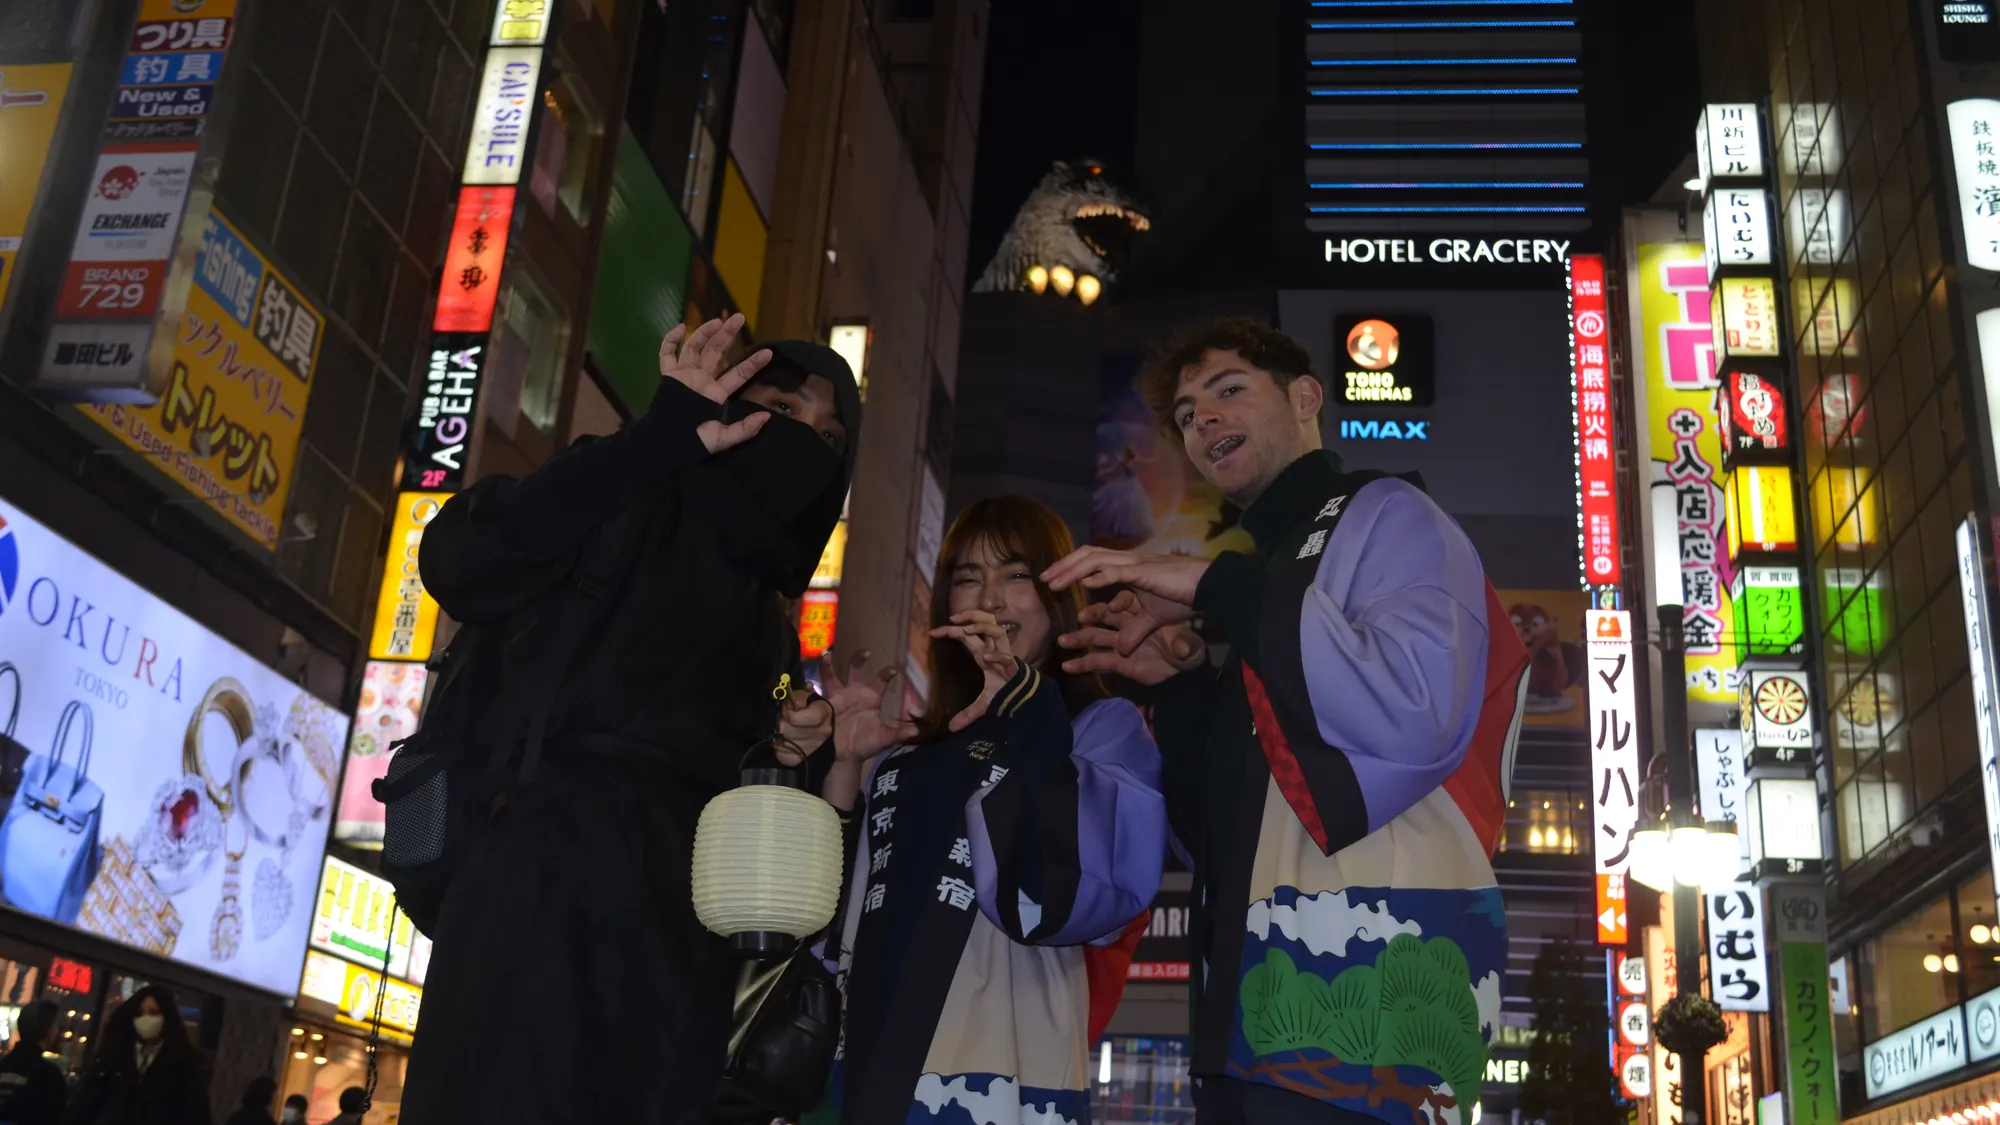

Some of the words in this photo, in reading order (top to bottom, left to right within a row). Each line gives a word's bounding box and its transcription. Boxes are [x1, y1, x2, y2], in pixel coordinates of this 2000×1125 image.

[1943, 4, 1984, 13] SHISHA
[1943, 14, 1988, 24] LOUNGE
[136, 17, 227, 50] つり具
[119, 88, 178, 104] New
[183, 88, 201, 101] &
[138, 102, 204, 117] Used
[485, 61, 530, 168] CAPSULE
[91, 213, 171, 231] EXCHANGE
[1325, 239, 1423, 263] HOTEL
[1429, 239, 1571, 263] GRACERY
[84, 268, 149, 281] BRAND
[77, 284, 145, 309] 729
[260, 278, 317, 377] 釣具
[428, 349, 450, 381] BAR
[428, 378, 443, 395] &
[1345, 372, 1394, 387] TOHO
[1345, 387, 1412, 401] CINEMAS
[419, 397, 440, 428] PUB
[431, 345, 482, 470] AGEHA
[1341, 420, 1427, 439] IMAX
[1739, 436, 1754, 449] 7F
[421, 470, 446, 487] 2F
[233, 499, 277, 543] tackle
[27, 577, 183, 704] OKURA
[74, 665, 129, 711] TOKYO
[1787, 729, 1811, 744] UP
[1592, 653, 1635, 868] マルハン
[1776, 747, 1796, 761] 4F
[865, 769, 899, 913] 東京新宿
[1787, 858, 1806, 873] 3F
[1714, 891, 1761, 1001] いむら
